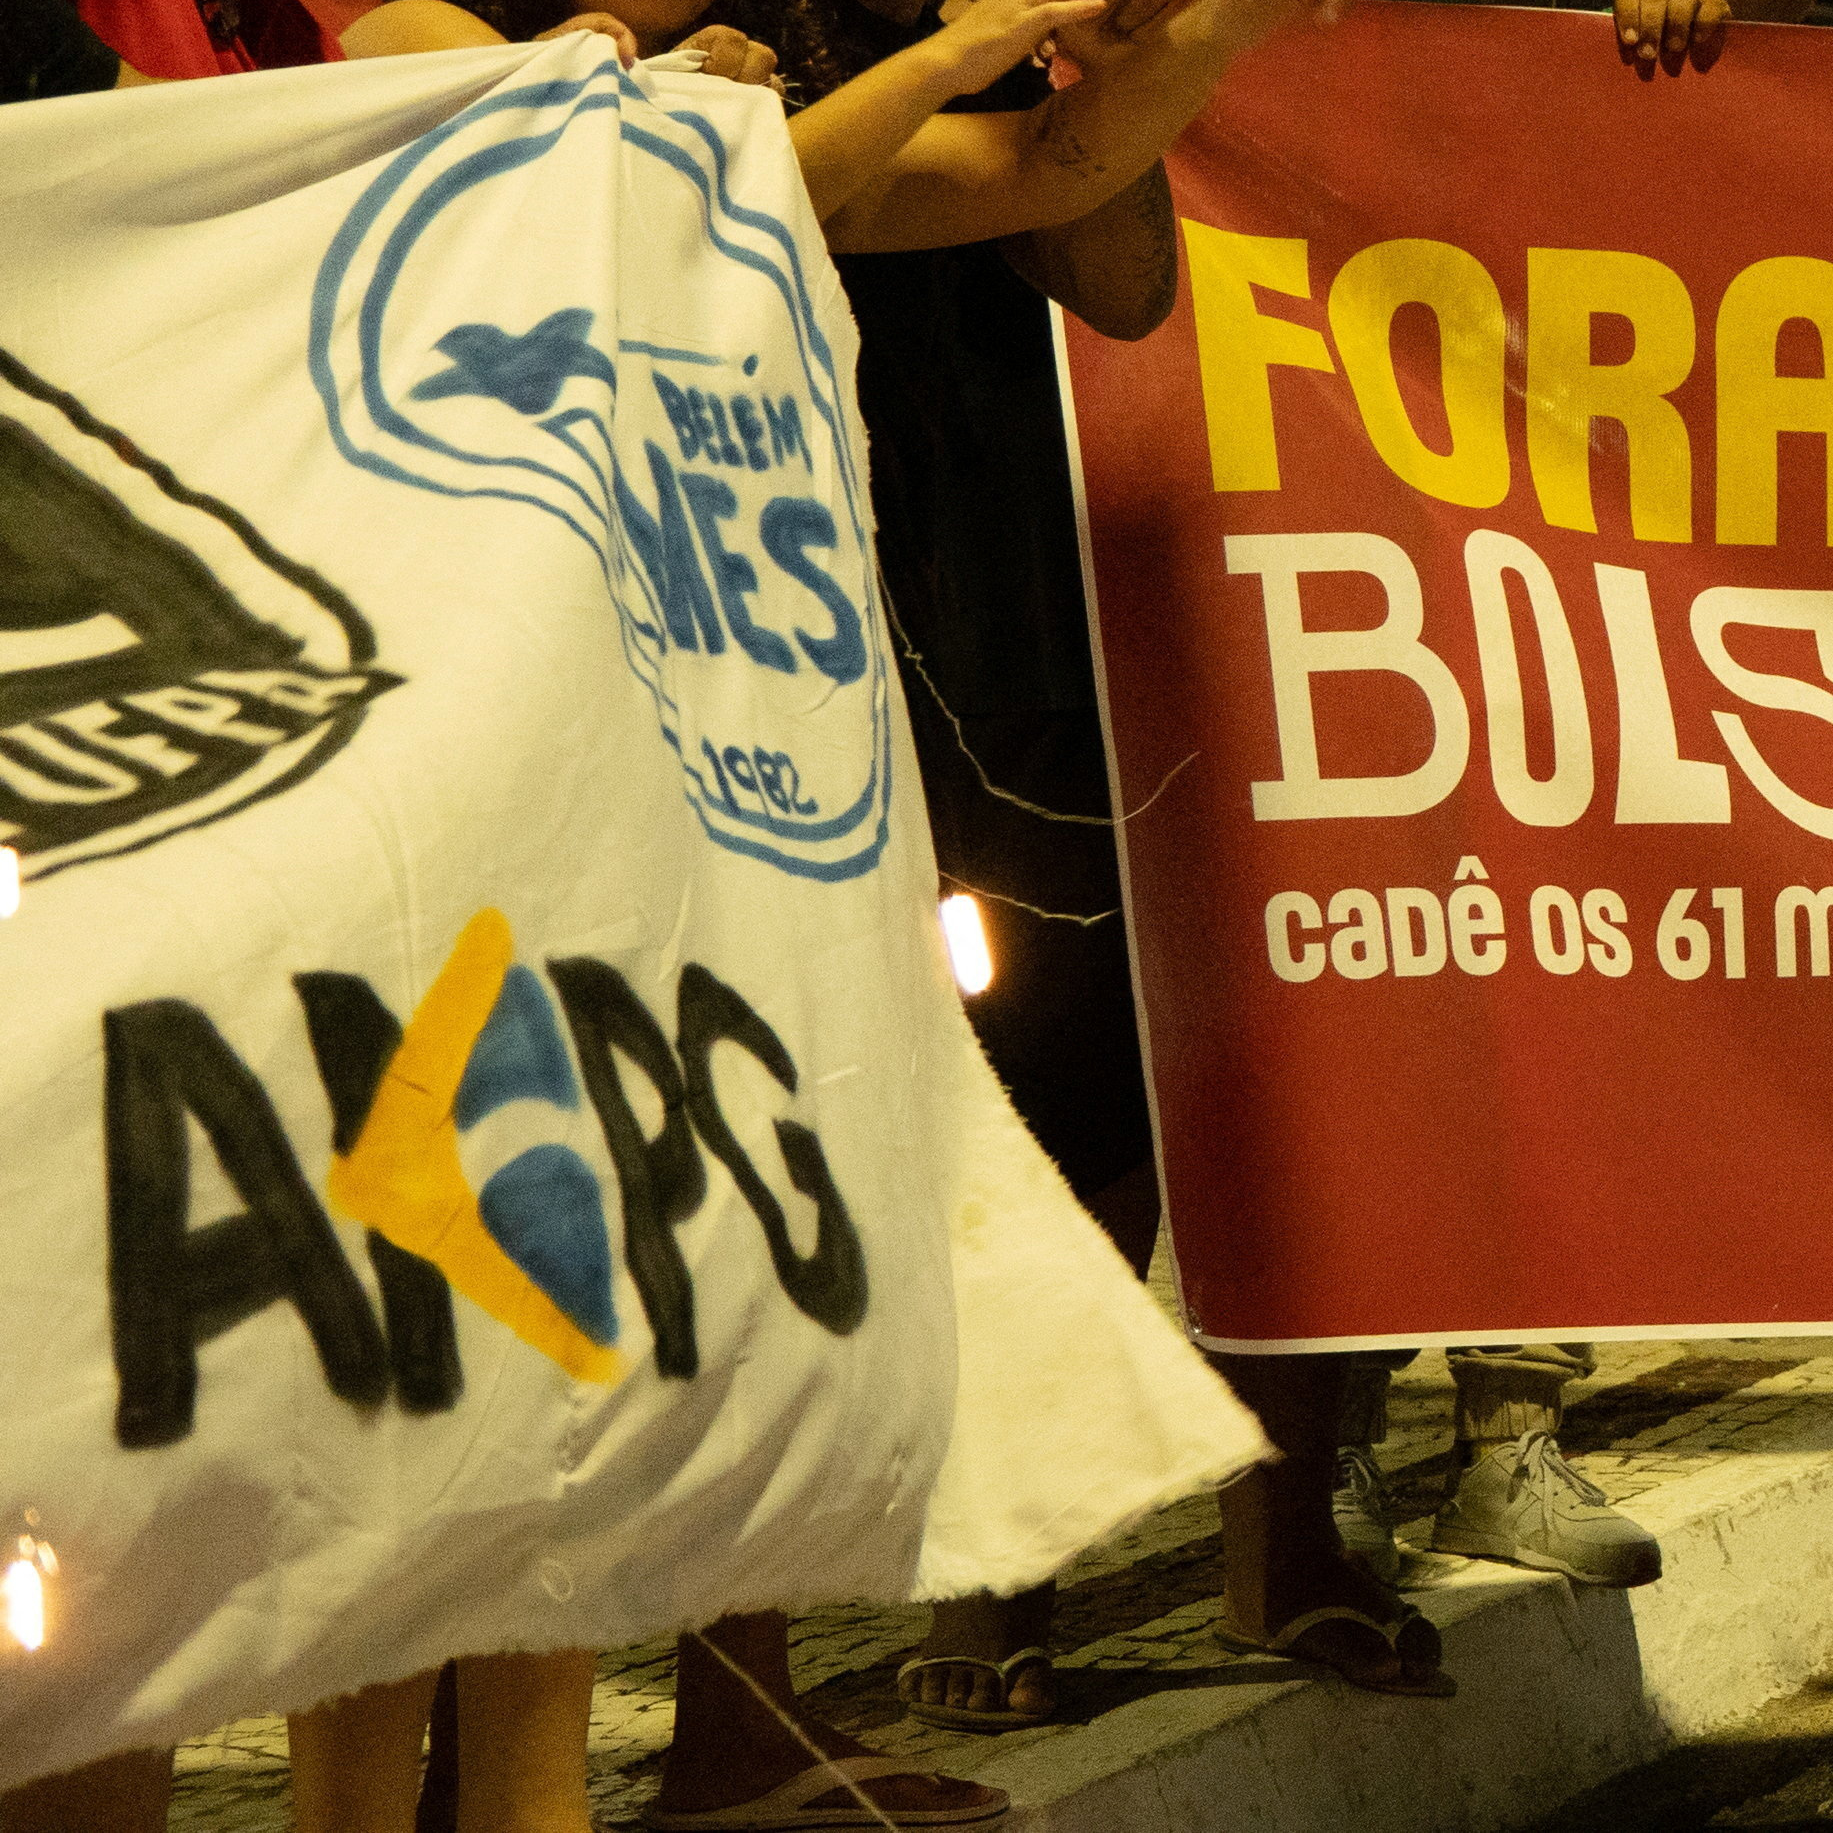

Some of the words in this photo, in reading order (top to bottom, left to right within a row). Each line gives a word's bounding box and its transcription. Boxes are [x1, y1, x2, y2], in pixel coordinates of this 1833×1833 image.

[701, 735, 819, 818] 1982
[1262, 854, 1507, 982] CADÊ
[1530, 884, 1634, 978] OS
[1654, 886, 1746, 980] 61
